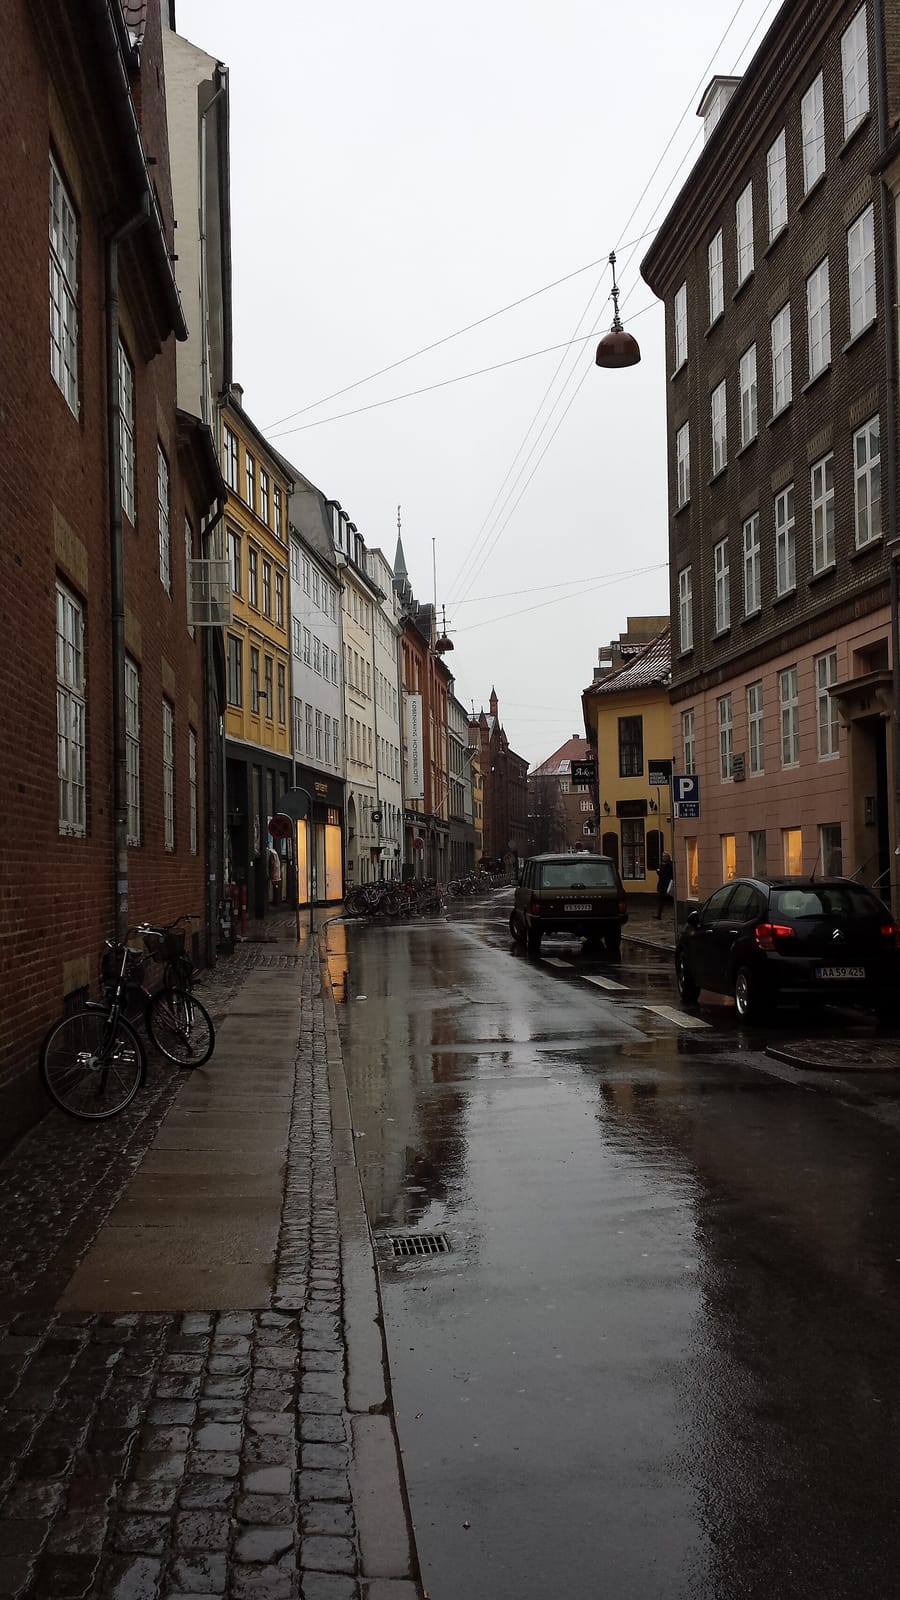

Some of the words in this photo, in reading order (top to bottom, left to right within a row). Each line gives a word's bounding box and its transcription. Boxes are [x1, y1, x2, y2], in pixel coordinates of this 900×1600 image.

[680, 778, 694, 799] P
[823, 967, 835, 977] AA
[836, 967, 847, 977] 59
[848, 967, 864, 977] 425
